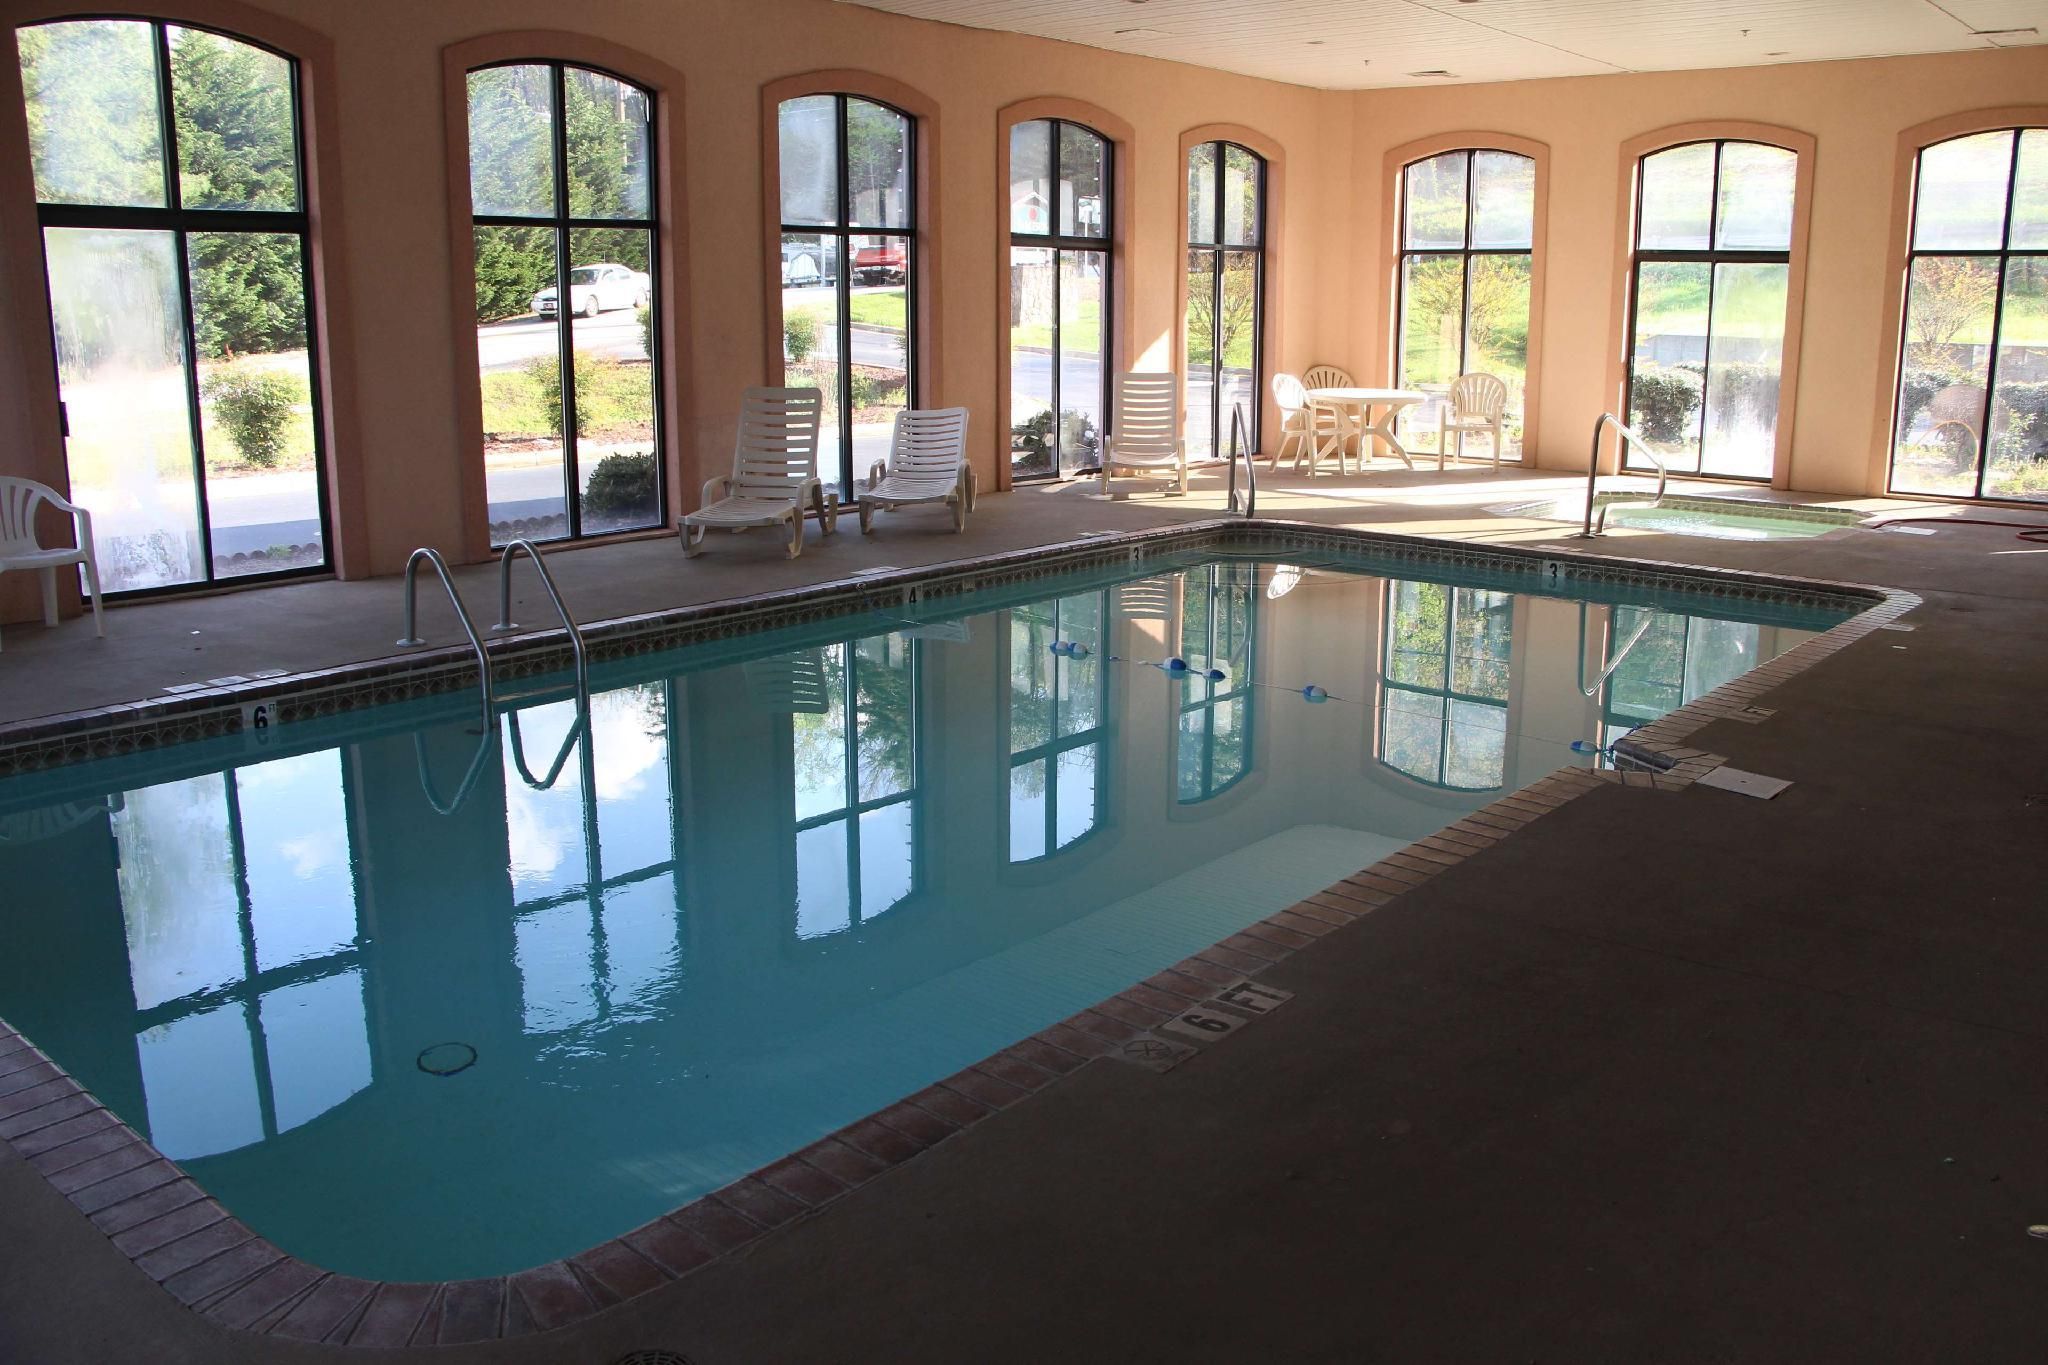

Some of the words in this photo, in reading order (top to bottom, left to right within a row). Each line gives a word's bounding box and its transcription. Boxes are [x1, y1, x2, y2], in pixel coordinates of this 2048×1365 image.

[1549, 563, 1557, 577] 3
[254, 706, 268, 728] 6
[268, 703, 276, 712] FT
[1181, 1014, 1231, 1032] 6
[1216, 982, 1285, 1013] FT
